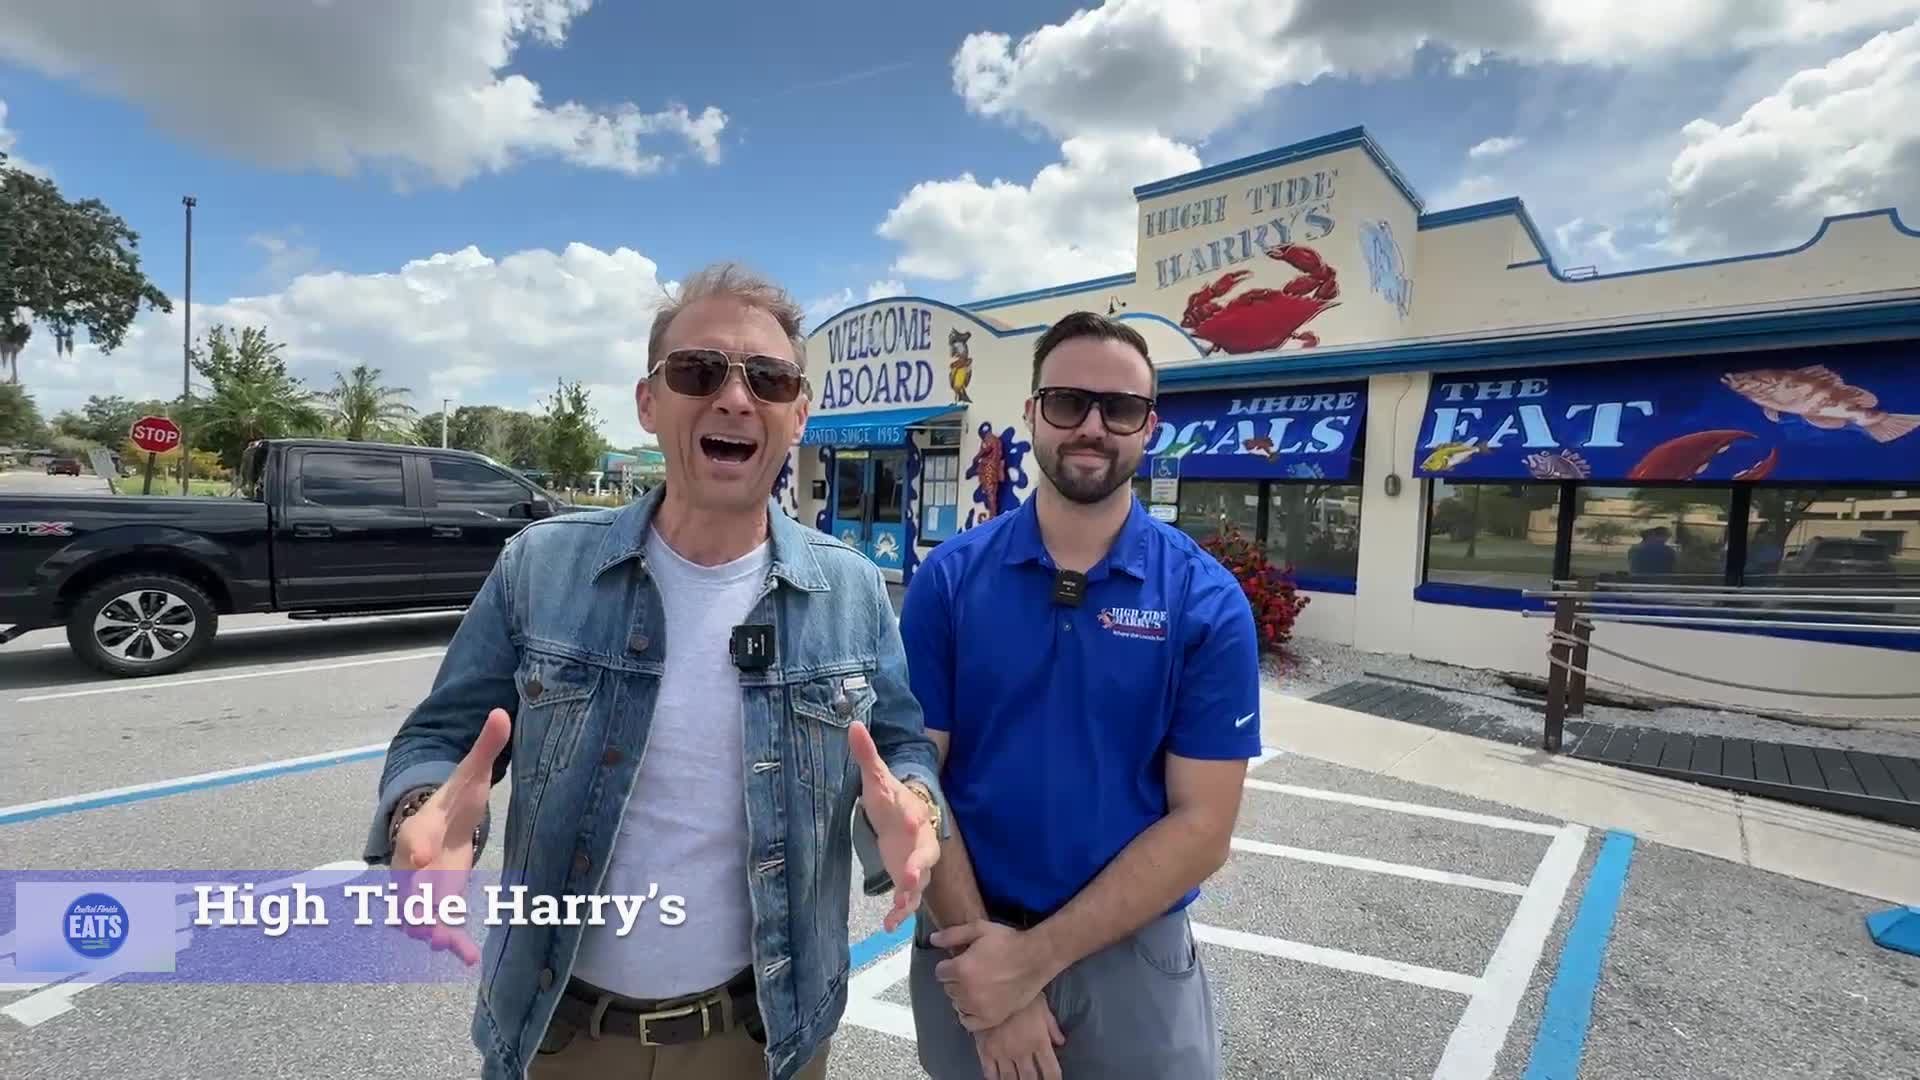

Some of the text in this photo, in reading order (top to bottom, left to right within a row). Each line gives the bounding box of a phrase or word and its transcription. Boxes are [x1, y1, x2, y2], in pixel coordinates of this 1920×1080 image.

[1144, 168, 1339, 238] HIGH TIDE
[1155, 204, 1336, 289] HARRY'S
[828, 307, 932, 364] WELCOME
[820, 360, 933, 409] ABOARD
[1227, 392, 1360, 415] WHERE
[1440, 378, 1549, 401] THE
[134, 425, 177, 443] STOP
[803, 426, 900, 444] ERATED SINCE 1995
[1142, 415, 1350, 455] OCALS
[1424, 400, 1654, 448] EAT
[1112, 607, 1167, 621] HIGH TIDE
